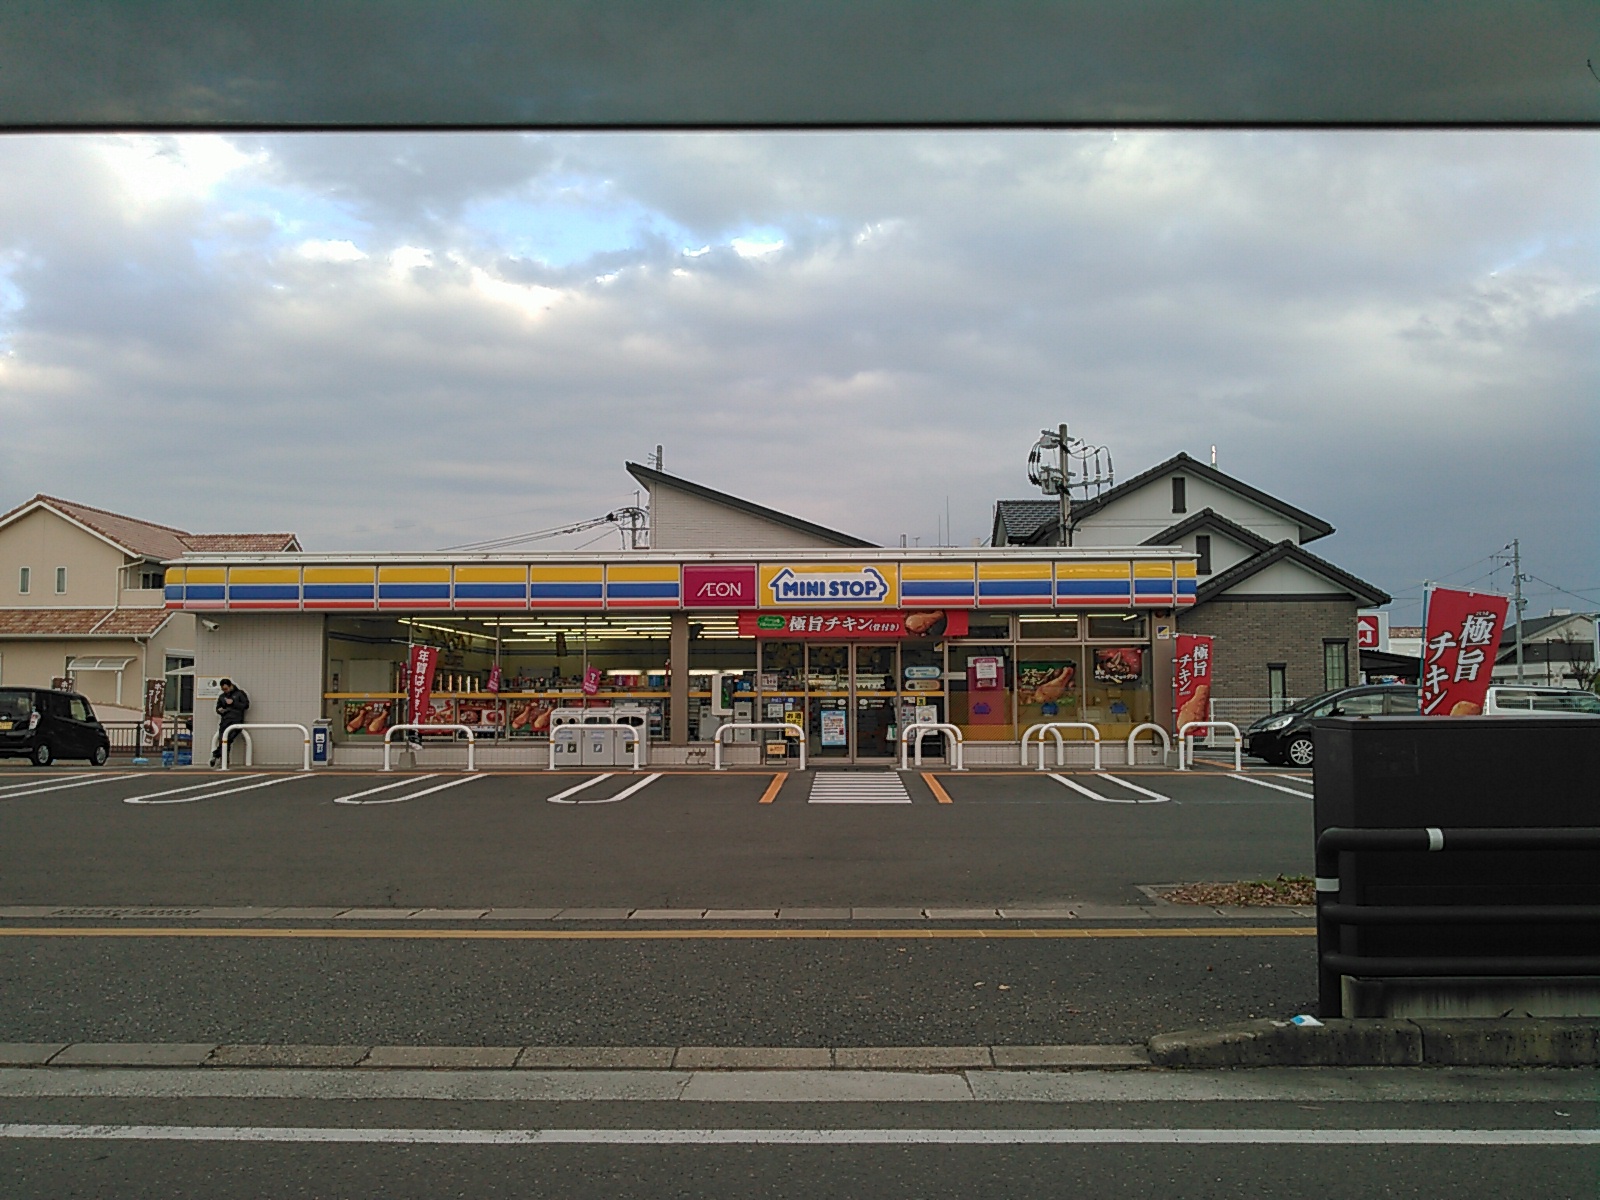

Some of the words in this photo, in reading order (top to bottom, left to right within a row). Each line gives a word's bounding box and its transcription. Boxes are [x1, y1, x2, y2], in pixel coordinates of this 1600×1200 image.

[782, 580, 826, 598] MINI
[828, 580, 877, 598] STOP
[1178, 653, 1193, 692] チキン
[1423, 631, 1457, 715] チキン
[1453, 613, 1497, 683] 極旨
